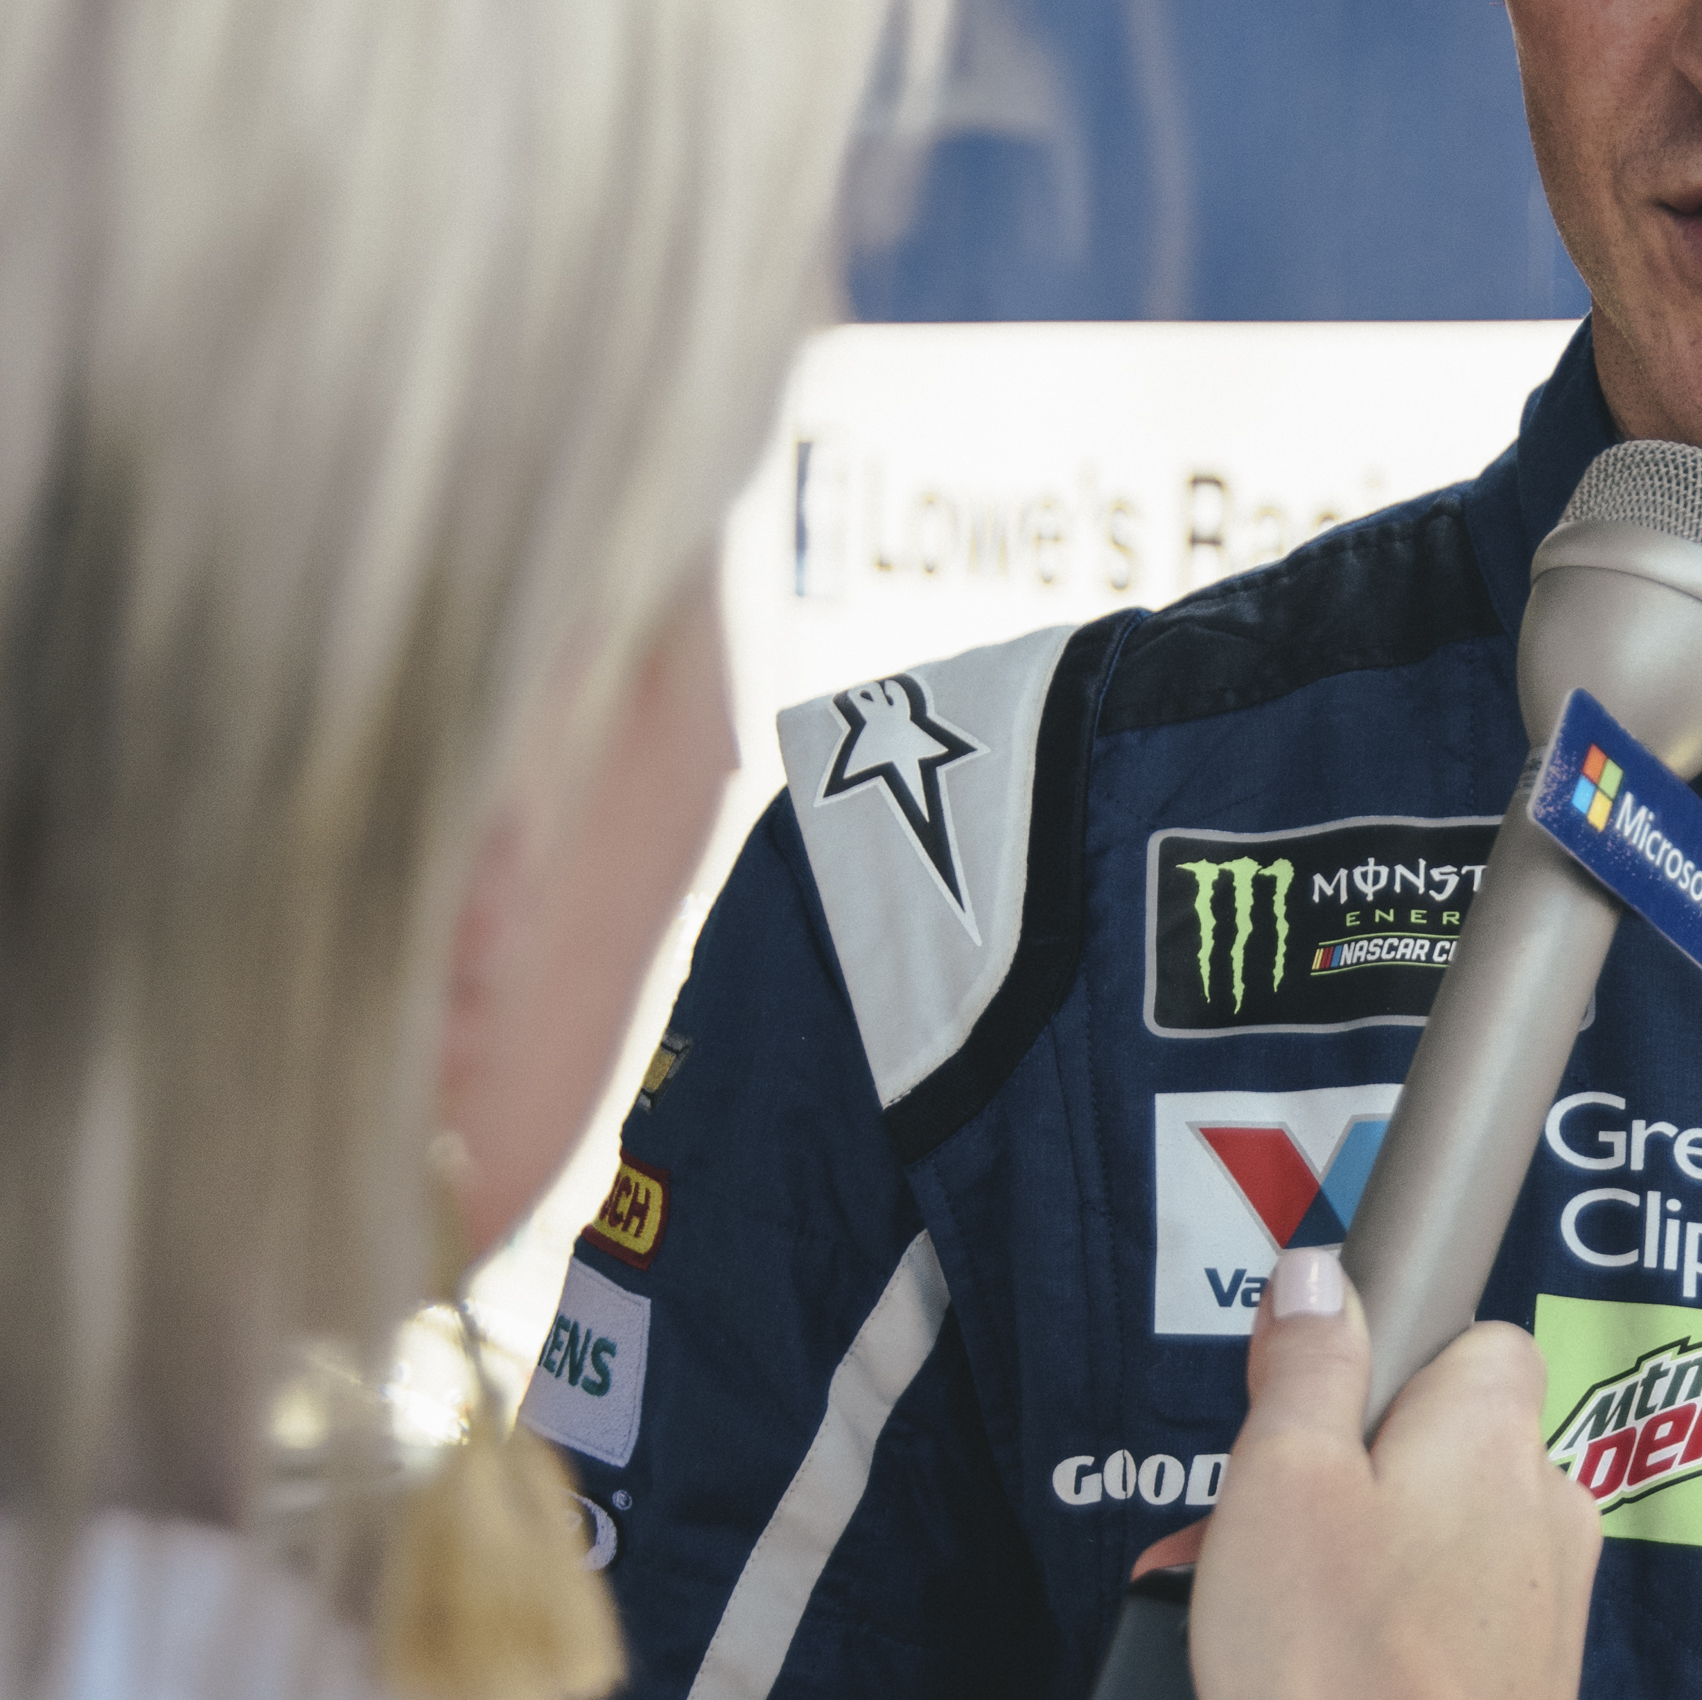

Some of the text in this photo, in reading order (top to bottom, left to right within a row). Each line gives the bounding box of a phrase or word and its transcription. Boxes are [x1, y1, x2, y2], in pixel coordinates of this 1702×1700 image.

[1312, 857, 1487, 905] MONST
[1345, 908, 1461, 927] ENER
[1340, 937, 1431, 966] NASCAR
[598, 1175, 651, 1238] CH
[540, 1314, 617, 1397] ENS
[1052, 1449, 1232, 1506] GOOD
